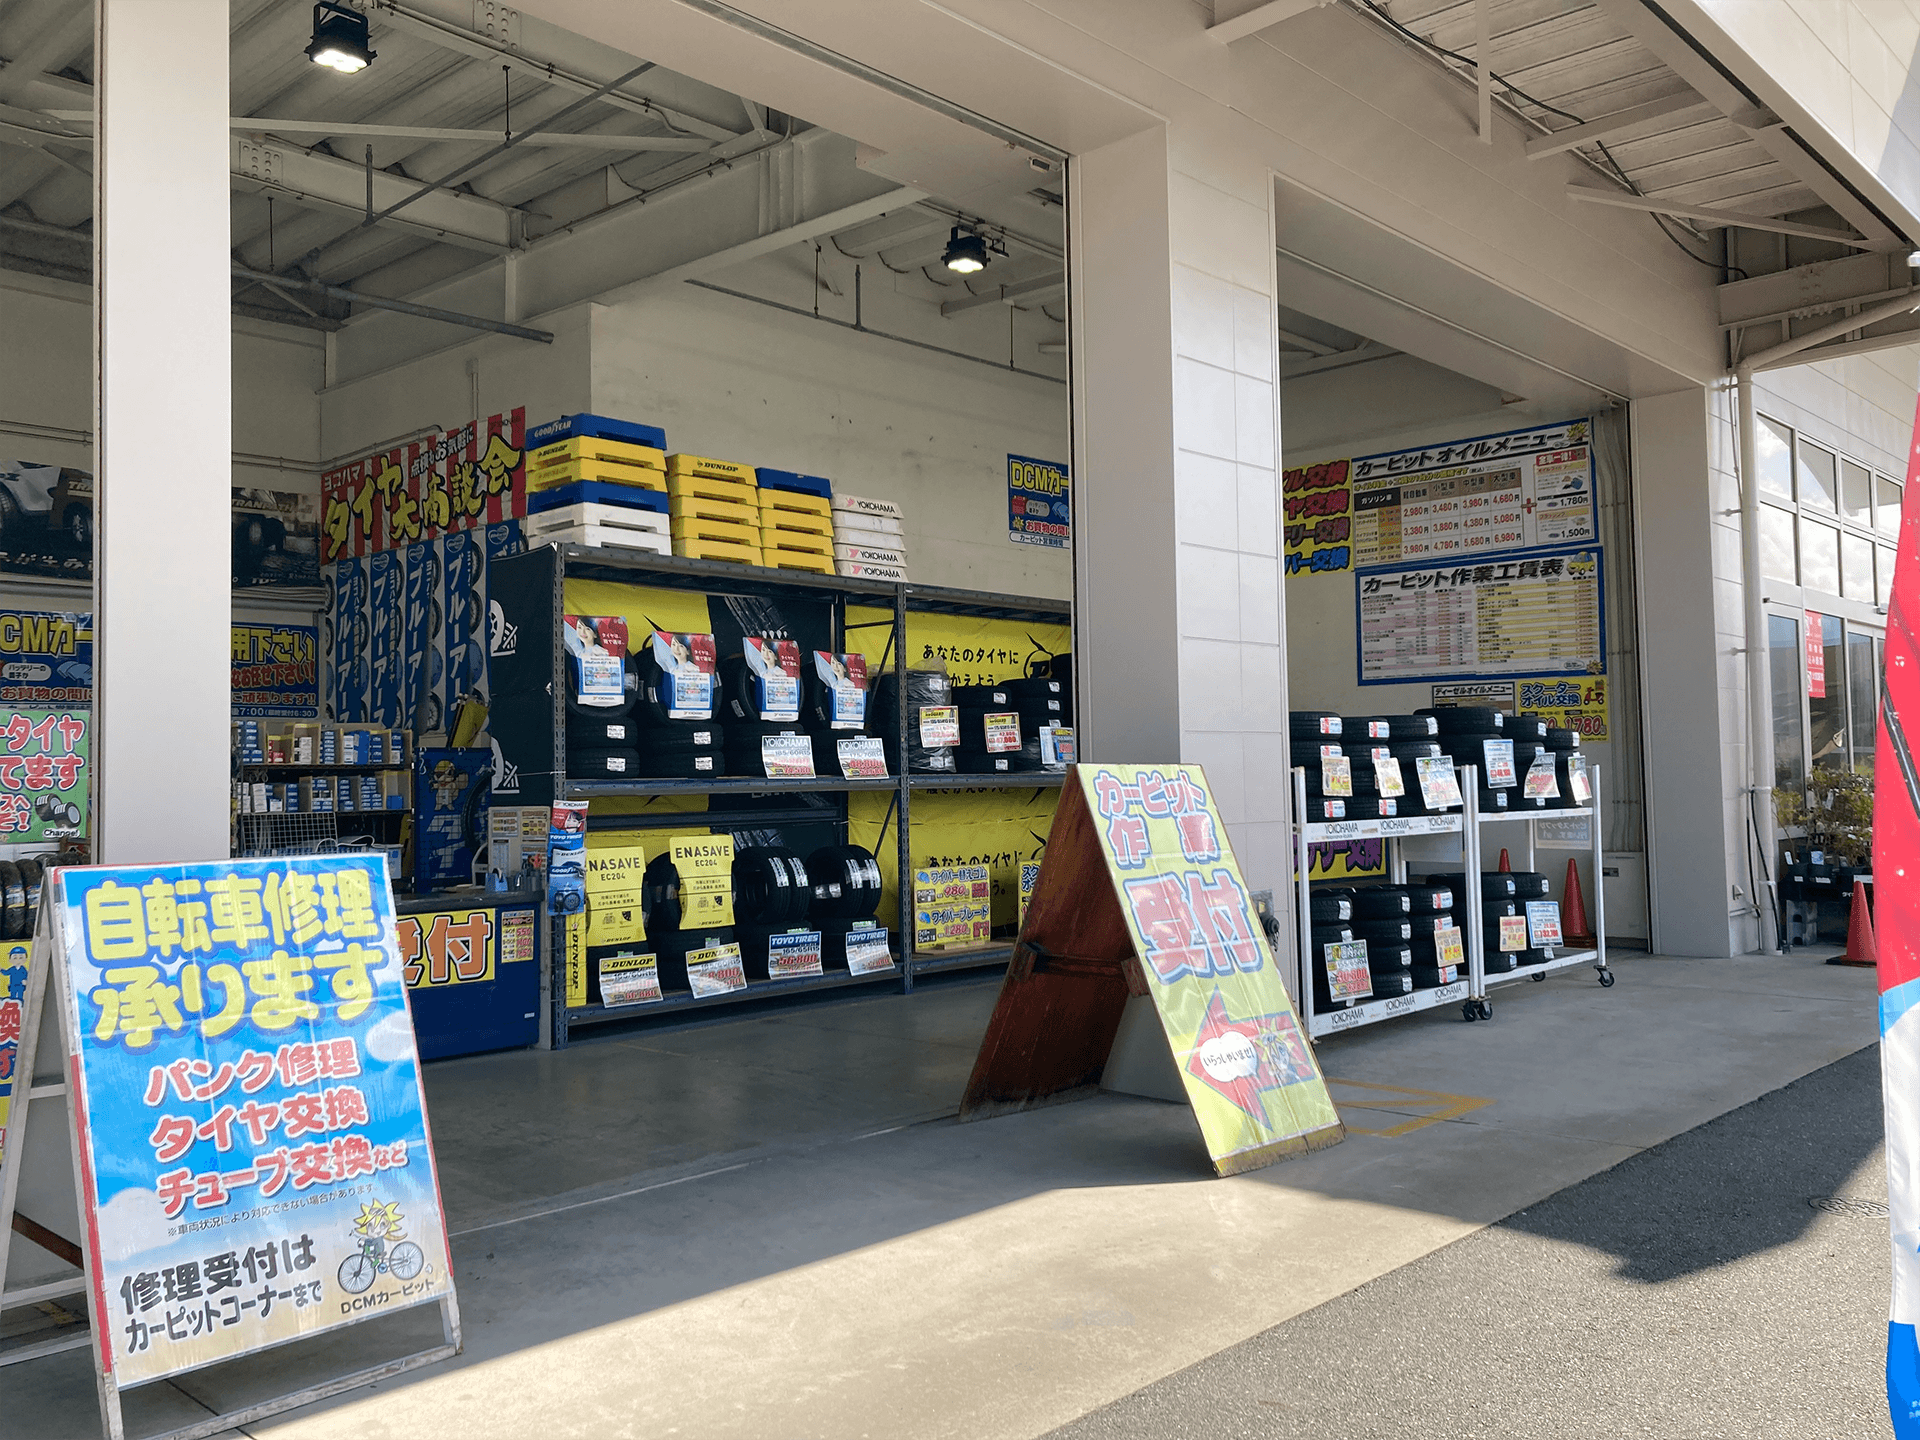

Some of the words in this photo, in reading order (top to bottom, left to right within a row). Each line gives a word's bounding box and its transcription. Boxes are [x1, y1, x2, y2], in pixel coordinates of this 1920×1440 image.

[534, 420, 572, 438] GOODYEAR
[543, 444, 568, 456] DUNLOP
[1355, 451, 1434, 478] カーピット
[1437, 432, 1565, 463] オイルメニュー
[704, 462, 738, 473] DUNLOP
[324, 465, 362, 491] ヨコハマ
[324, 434, 522, 560] タイヤ大商談会
[856, 500, 896, 513] YOKOHAMA
[860, 551, 898, 563] YOKOHAMA
[863, 567, 901, 579] YOKOHAMA
[1362, 558, 1565, 595] カーピット作業工賃表
[922, 644, 1019, 664] あなたのタイヤに
[1435, 685, 1512, 696] ディーゼルオイルメニュー
[1520, 680, 1581, 696] スクーター
[1520, 693, 1582, 708] オイル交換
[763, 737, 809, 748] YOKOHAMA
[840, 741, 881, 750] YOKOHAMA
[1094, 771, 1206, 817] カーピット
[1324, 822, 1359, 834] YOKOHAMA
[1380, 820, 1411, 830] YOKOHAMA
[1428, 816, 1456, 827] YOKOHAMA
[43, 828, 80, 838] Change!
[675, 845, 730, 859] ENASAVE
[588, 857, 641, 872] NASAVE
[600, 872, 626, 882] EC204
[931, 866, 988, 884] ワイパー替えゴム
[943, 885, 966, 898] 980
[85, 868, 379, 960] 自転車修理
[931, 905, 990, 924] ワイパーブレード
[1124, 870, 1263, 983] 受付
[772, 936, 794, 946] TOYO
[795, 934, 819, 943] TIRES
[847, 934, 868, 942] TOYO
[868, 930, 886, 940] TIRES
[696, 947, 738, 960] DUNLOP
[610, 956, 653, 968] DUNLOP
[92, 942, 383, 1048] 承ります
[1434, 984, 1462, 999] YOKOHAMA
[1385, 995, 1416, 1011] YOKOHAMA
[1330, 1008, 1365, 1025] YOKOHAMA
[1202, 1046, 1255, 1067] いらっしゃいませ!
[145, 1038, 359, 1105] パンク修理
[151, 1088, 367, 1160] タイヤ交換
[157, 1137, 407, 1217] チューブ交換など
[119, 1234, 317, 1315] 修理受付は
[340, 1278, 435, 1315] DCMカーピット
[124, 1279, 323, 1354] カーピットコーナーまで
